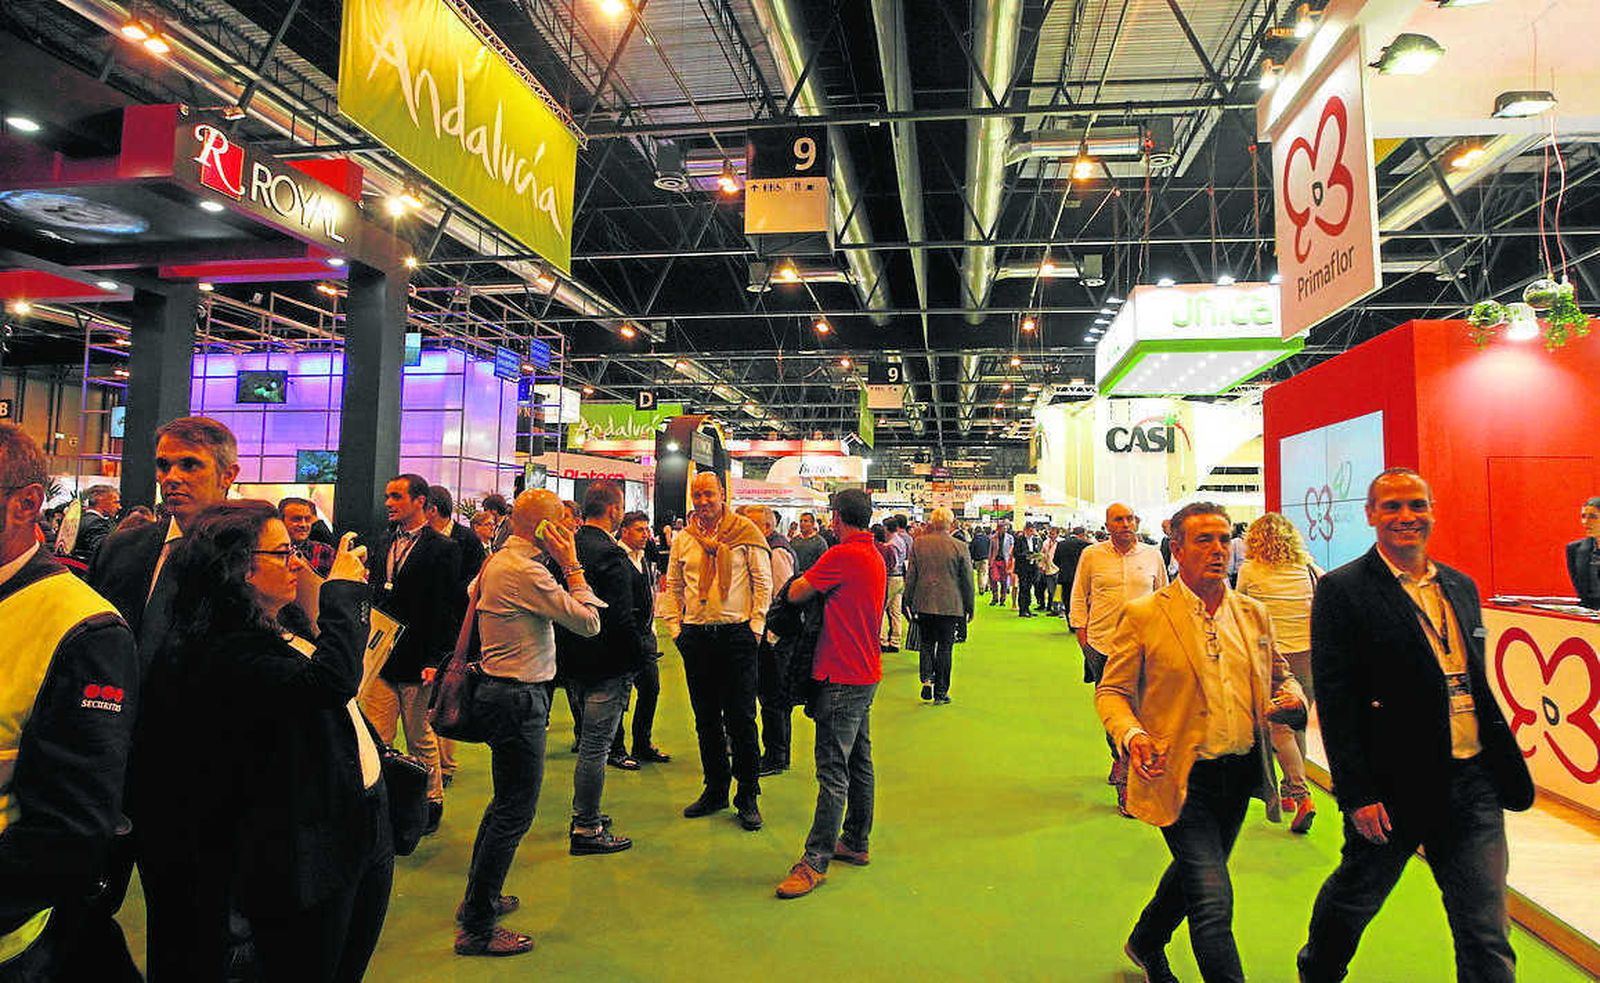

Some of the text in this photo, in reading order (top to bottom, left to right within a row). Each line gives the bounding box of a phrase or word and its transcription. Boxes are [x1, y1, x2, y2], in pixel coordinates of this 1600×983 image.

[367, 8, 566, 241] Andalucía
[793, 136, 817, 171] 9
[250, 161, 347, 243] ROYAL
[1297, 245, 1354, 302] Primaflor
[888, 367, 899, 382] 9
[639, 391, 653, 408] D
[1106, 426, 1176, 454] CASI
